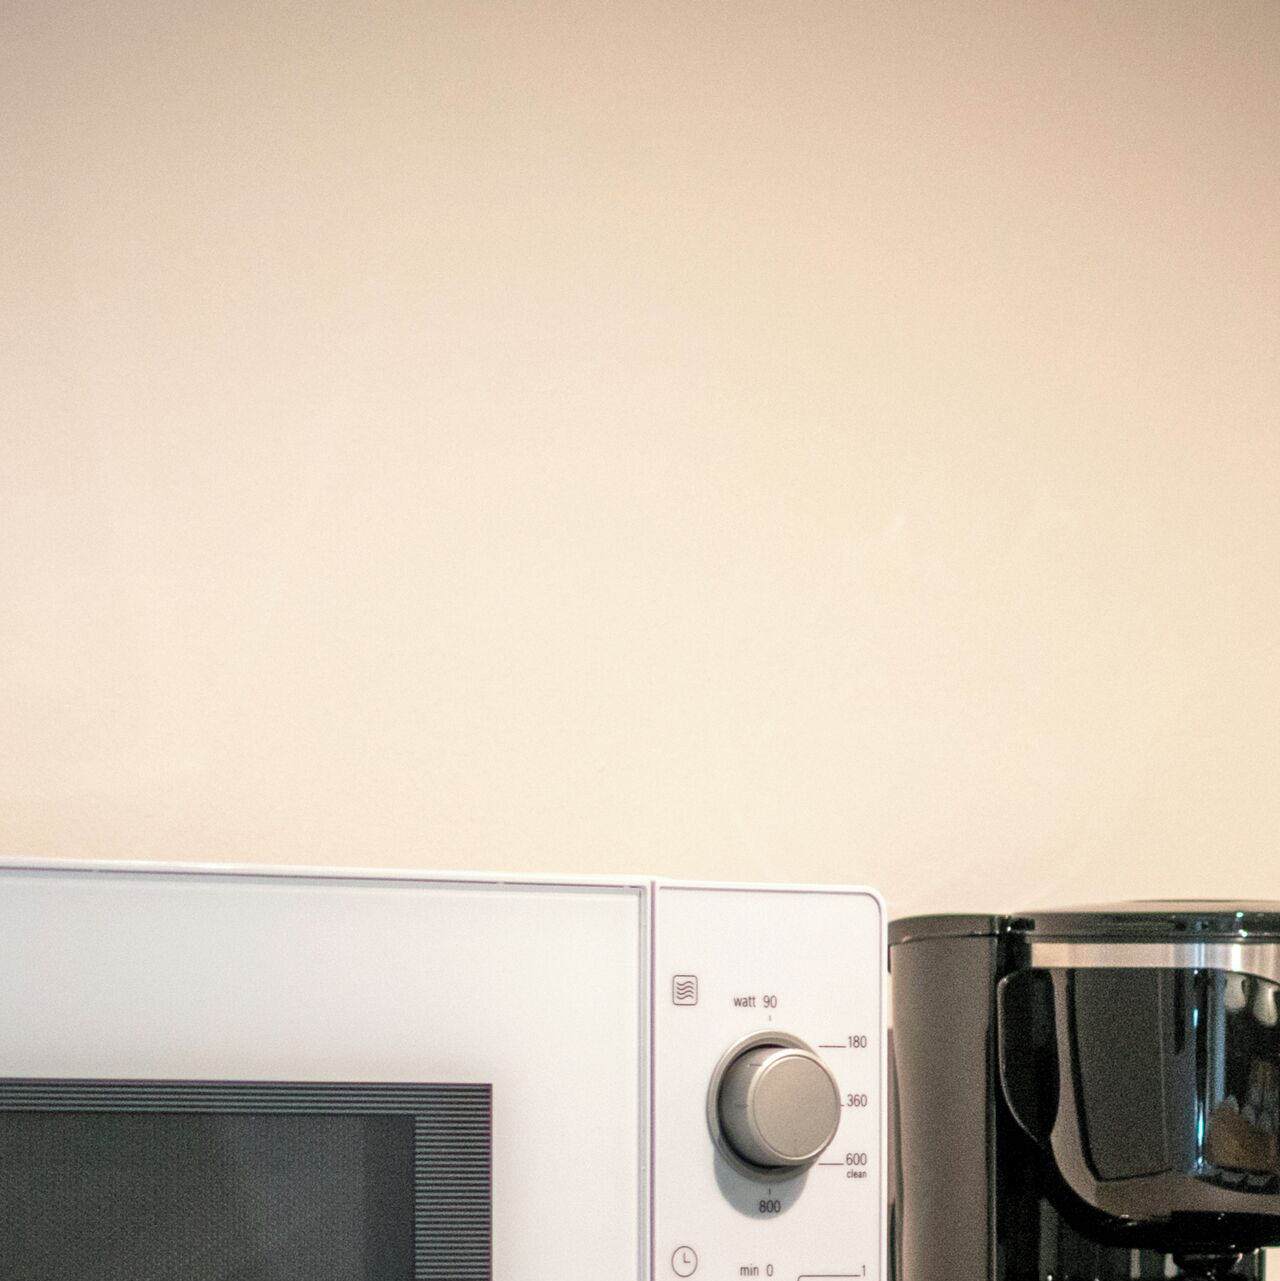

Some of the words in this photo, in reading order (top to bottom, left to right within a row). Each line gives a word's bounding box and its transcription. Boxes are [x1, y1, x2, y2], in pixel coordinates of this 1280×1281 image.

[733, 995, 757, 1008] watt
[762, 994, 778, 1009] 90
[847, 1035, 868, 1049] 180
[846, 1093, 868, 1108] 360
[845, 1152, 868, 1167] 600
[846, 1169, 868, 1179] clean
[758, 1200, 782, 1214] 800
[739, 1264, 760, 1277] min
[765, 1263, 774, 1278] 0
